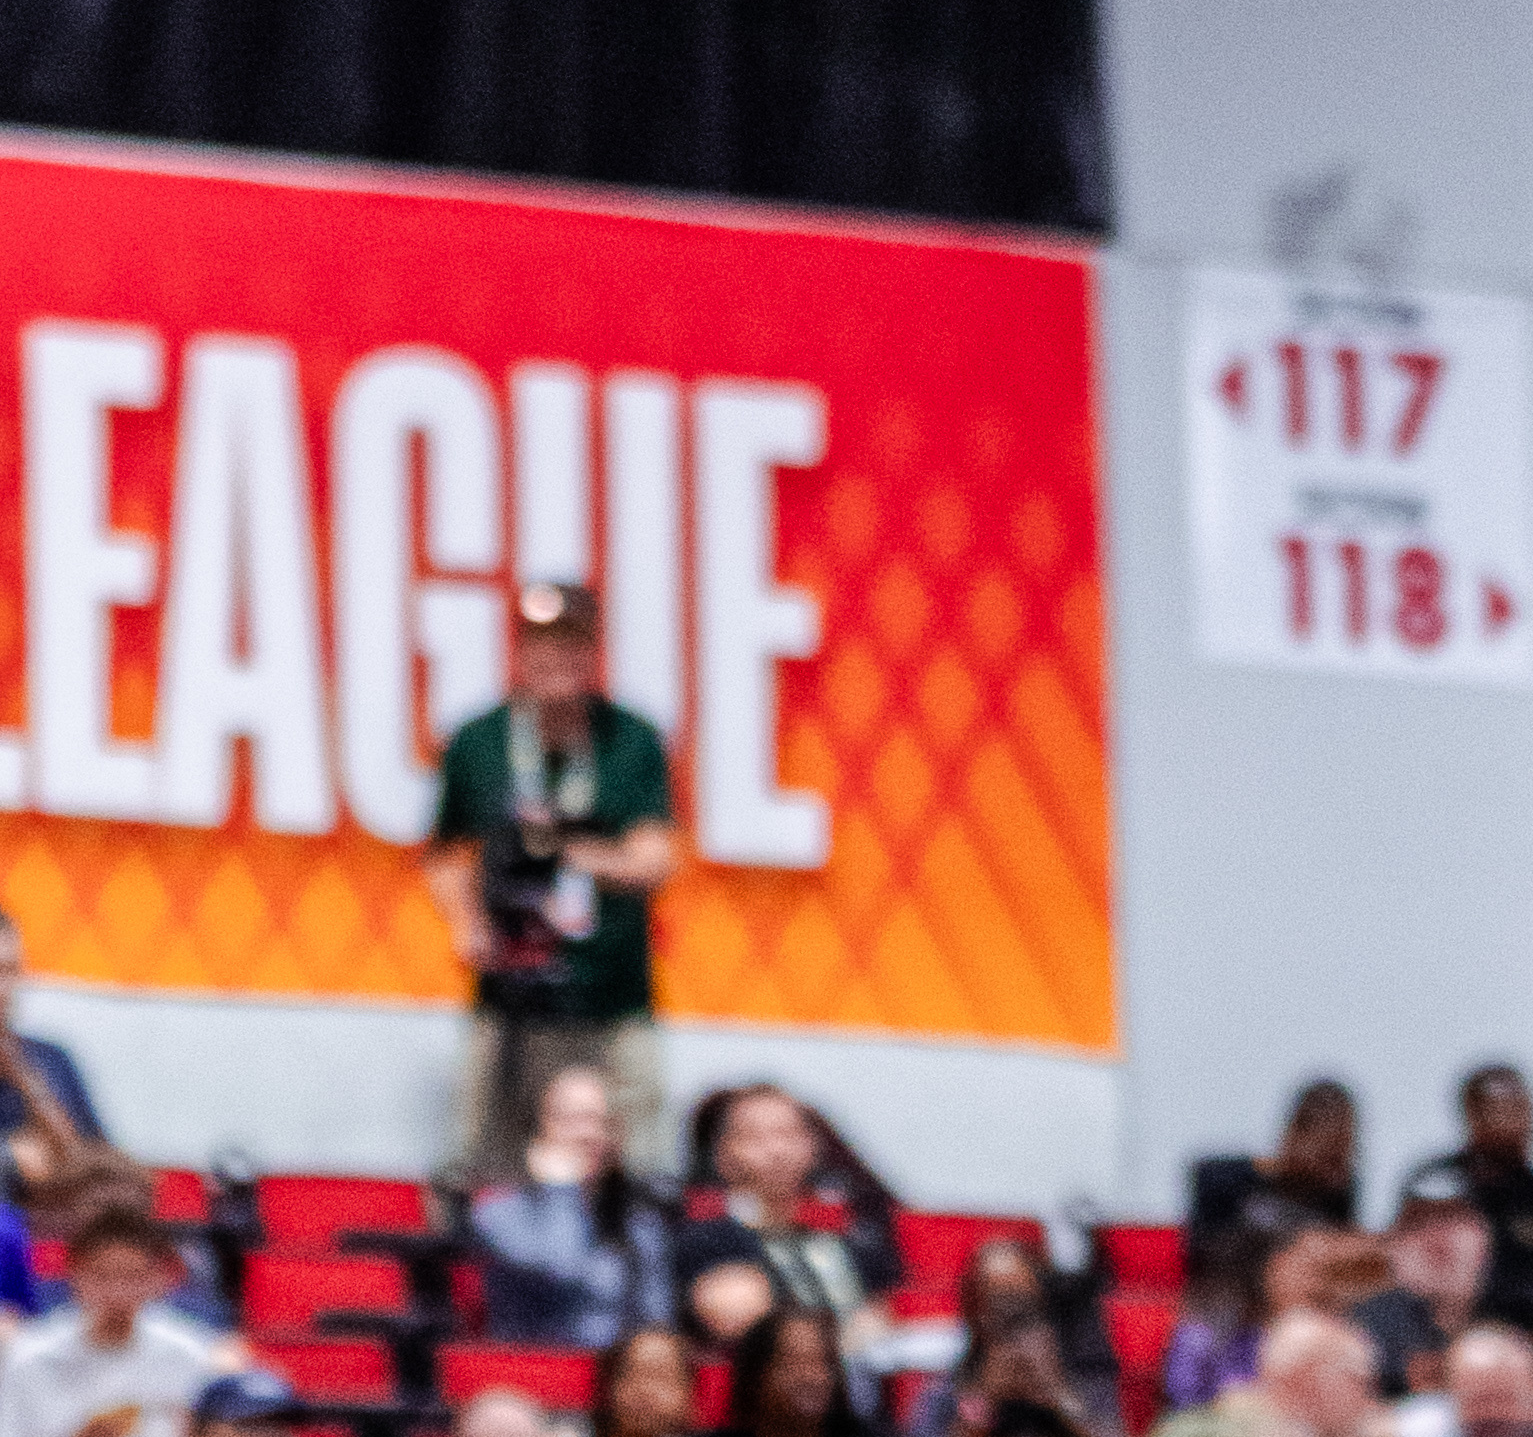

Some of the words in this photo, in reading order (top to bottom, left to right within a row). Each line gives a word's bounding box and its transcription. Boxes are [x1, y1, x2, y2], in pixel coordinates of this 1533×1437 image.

[1272, 333, 1448, 459] 117
[0, 315, 832, 869] EAGUE
[1276, 527, 1450, 654] 118
